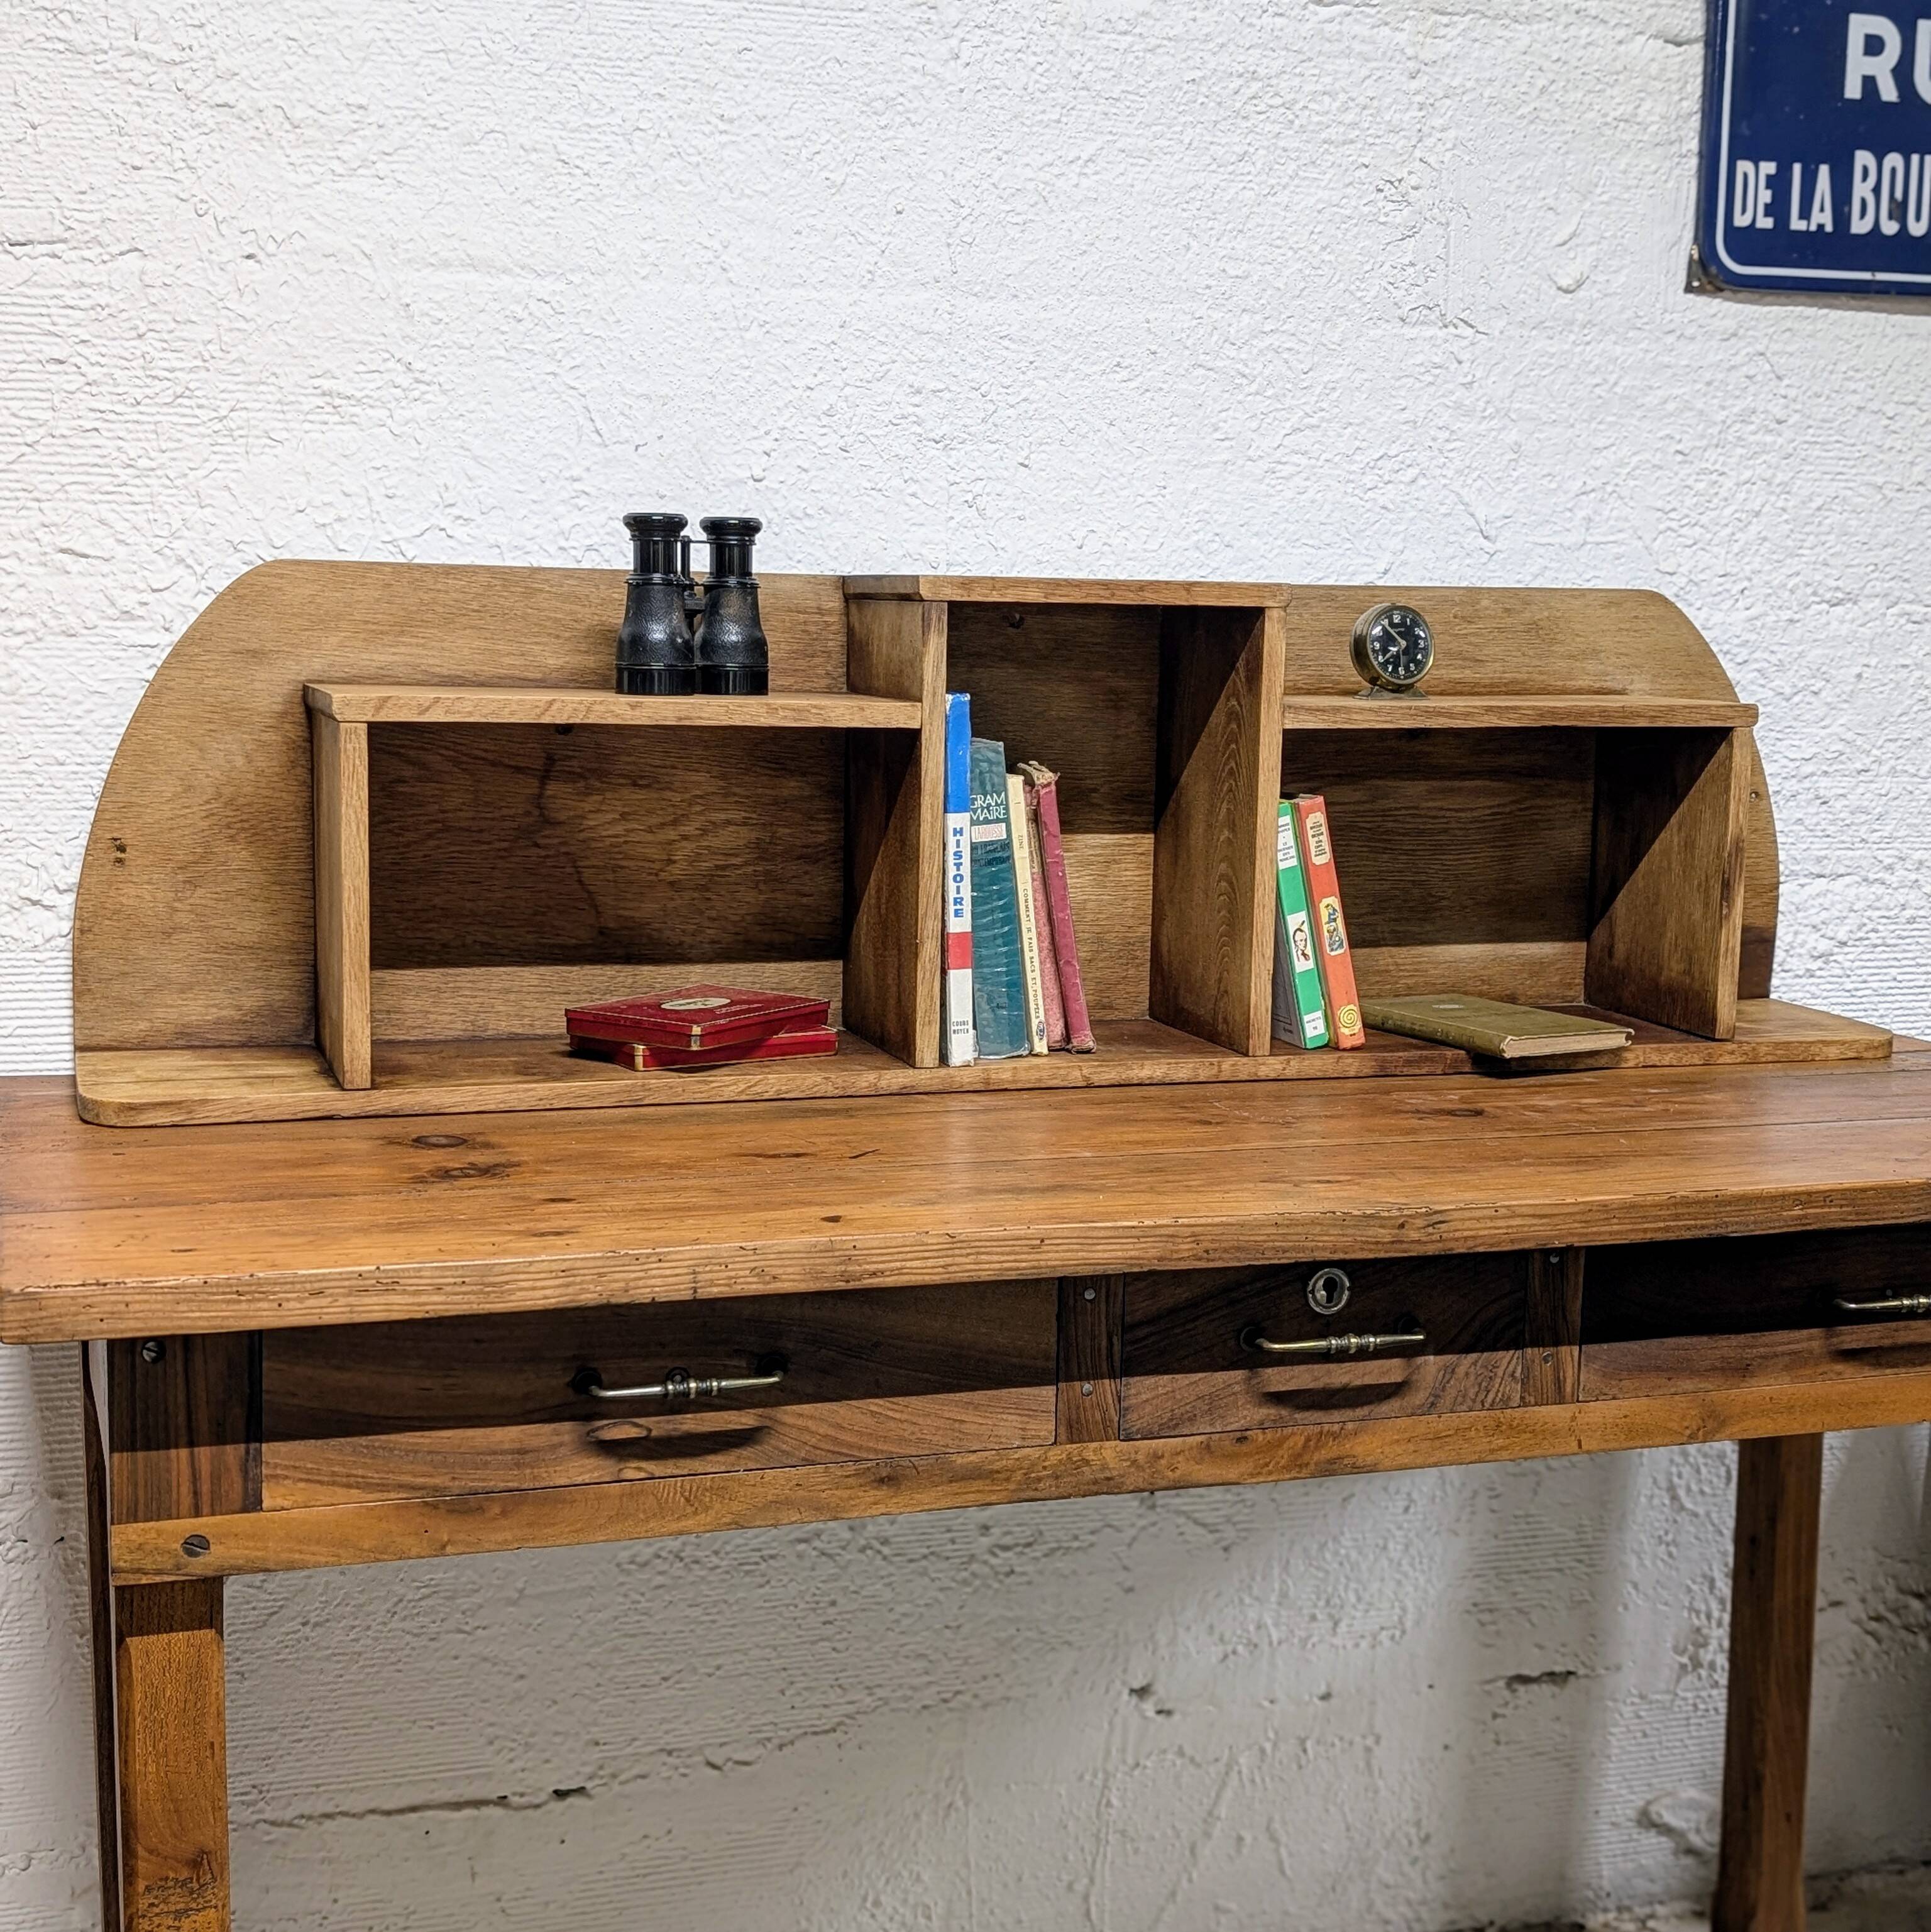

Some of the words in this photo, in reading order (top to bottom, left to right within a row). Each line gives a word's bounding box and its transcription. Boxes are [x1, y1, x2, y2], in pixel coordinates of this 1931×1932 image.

[1733, 159, 1777, 229] DE
[1790, 162, 1834, 233] LA
[1393, 614, 1401, 623] 12
[1373, 642, 1380, 650] 9
[1399, 667, 1405, 675] 6
[970, 791, 1006, 808] GRAM
[952, 827, 964, 918] HISTOIRE
[1023, 888, 1031, 923] COMMENT
